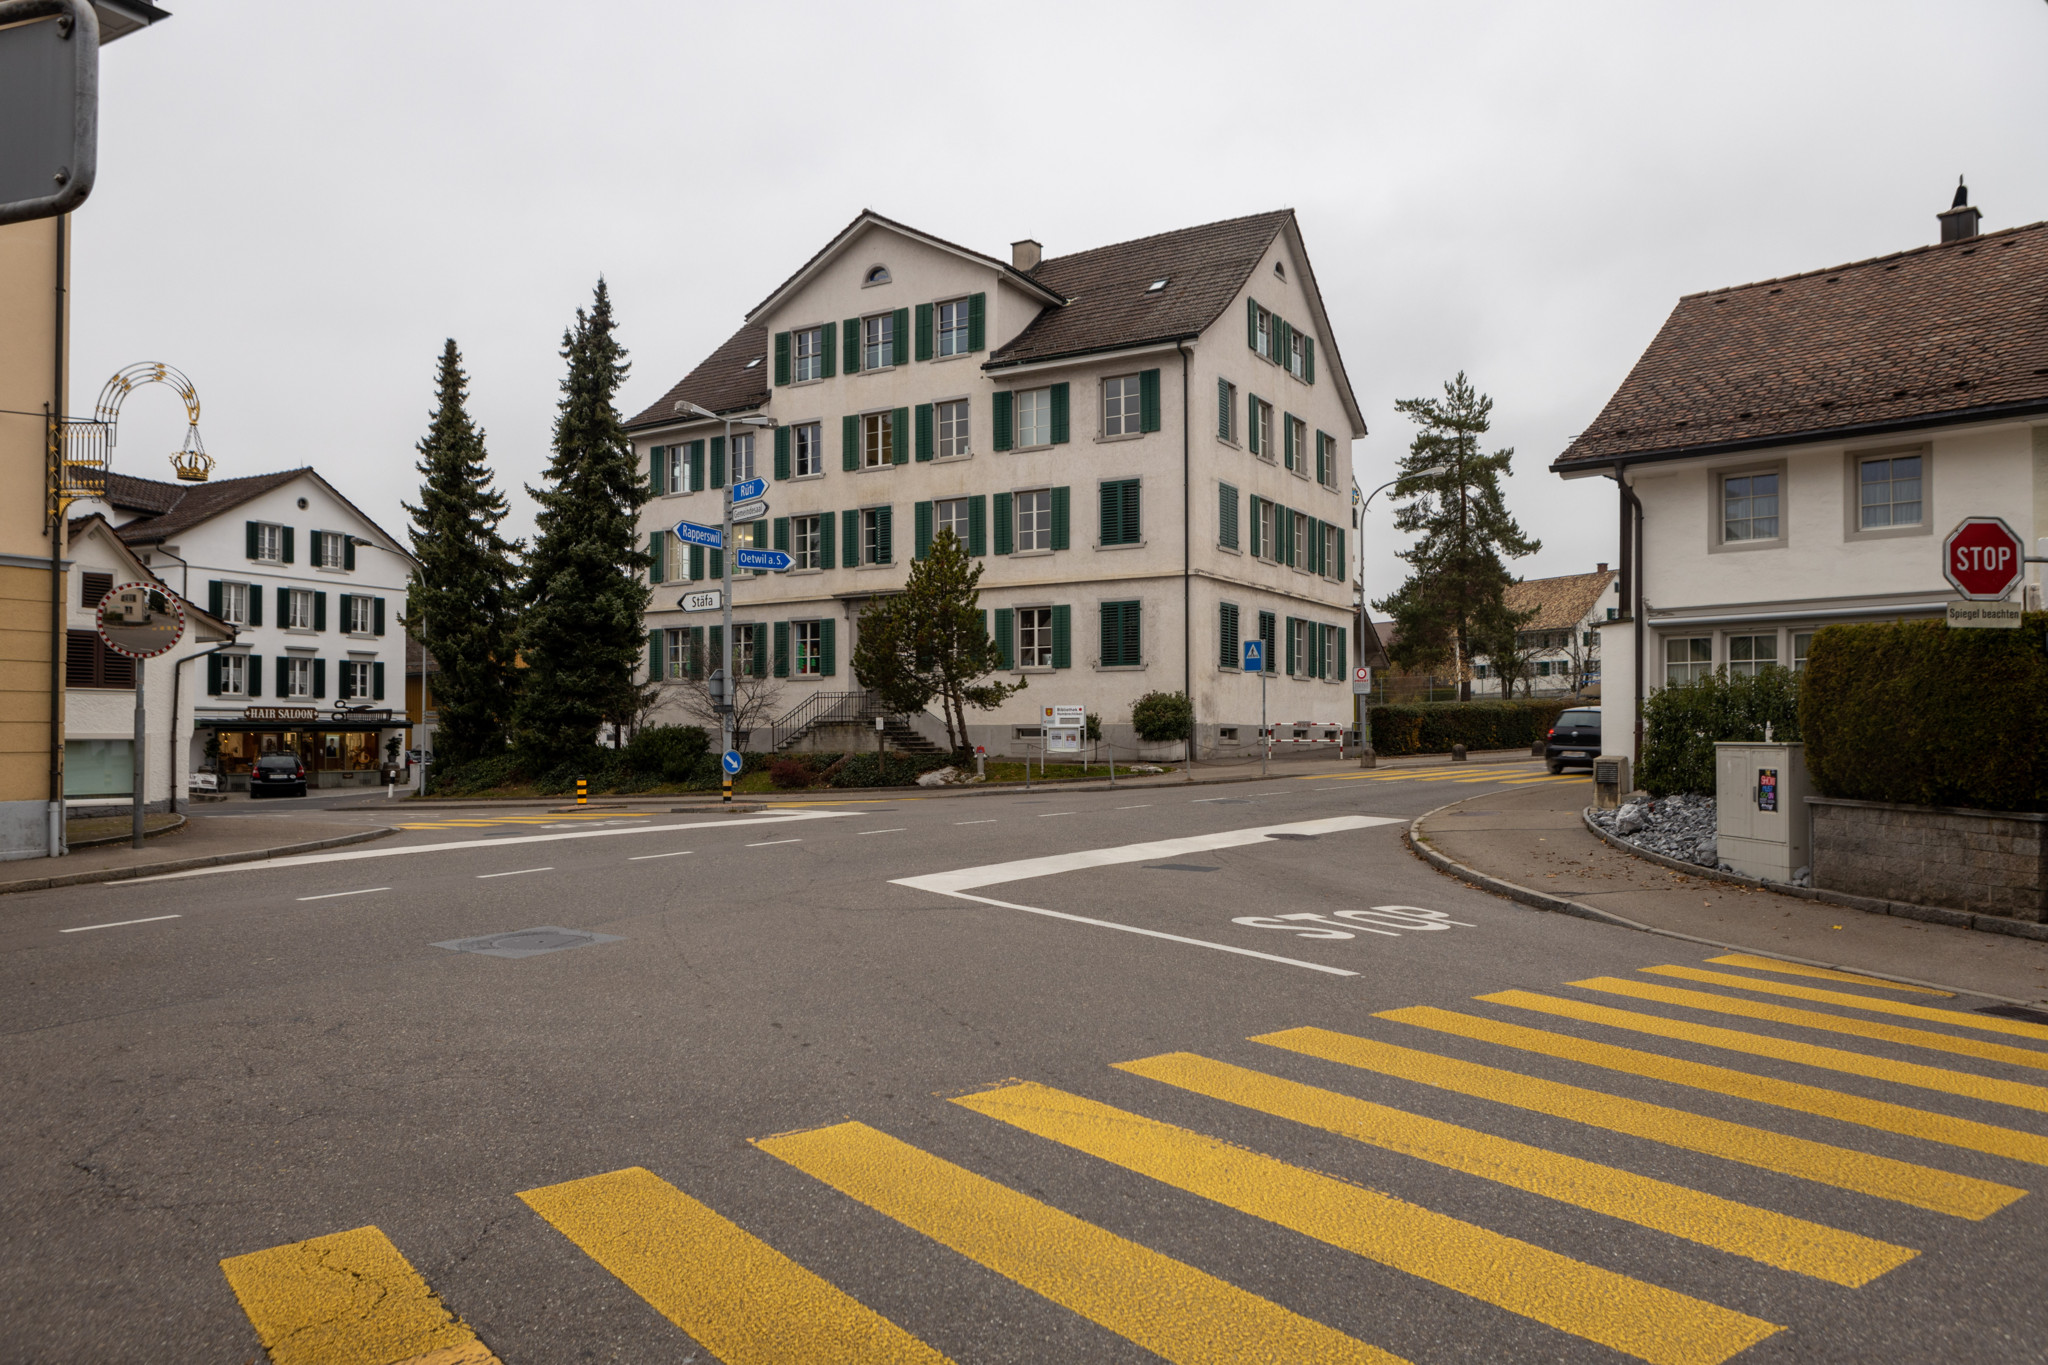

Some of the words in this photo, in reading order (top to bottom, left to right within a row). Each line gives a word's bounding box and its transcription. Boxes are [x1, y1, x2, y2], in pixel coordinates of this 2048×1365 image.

[740, 482, 755, 497] Rüti
[734, 503, 762, 519] Gemeindesaal
[682, 524, 720, 544] Rapperswil
[740, 553, 767, 564] Oetwil
[1957, 546, 2011, 571] STOP
[691, 594, 713, 608] Stäfa
[1949, 608, 1980, 620] Spiegel
[1982, 608, 2019, 619] beachten
[250, 708, 276, 719] HAIR
[278, 708, 314, 719] SALOON
[1760, 775, 1776, 786] SHOW
[1231, 905, 1477, 939] STOP
